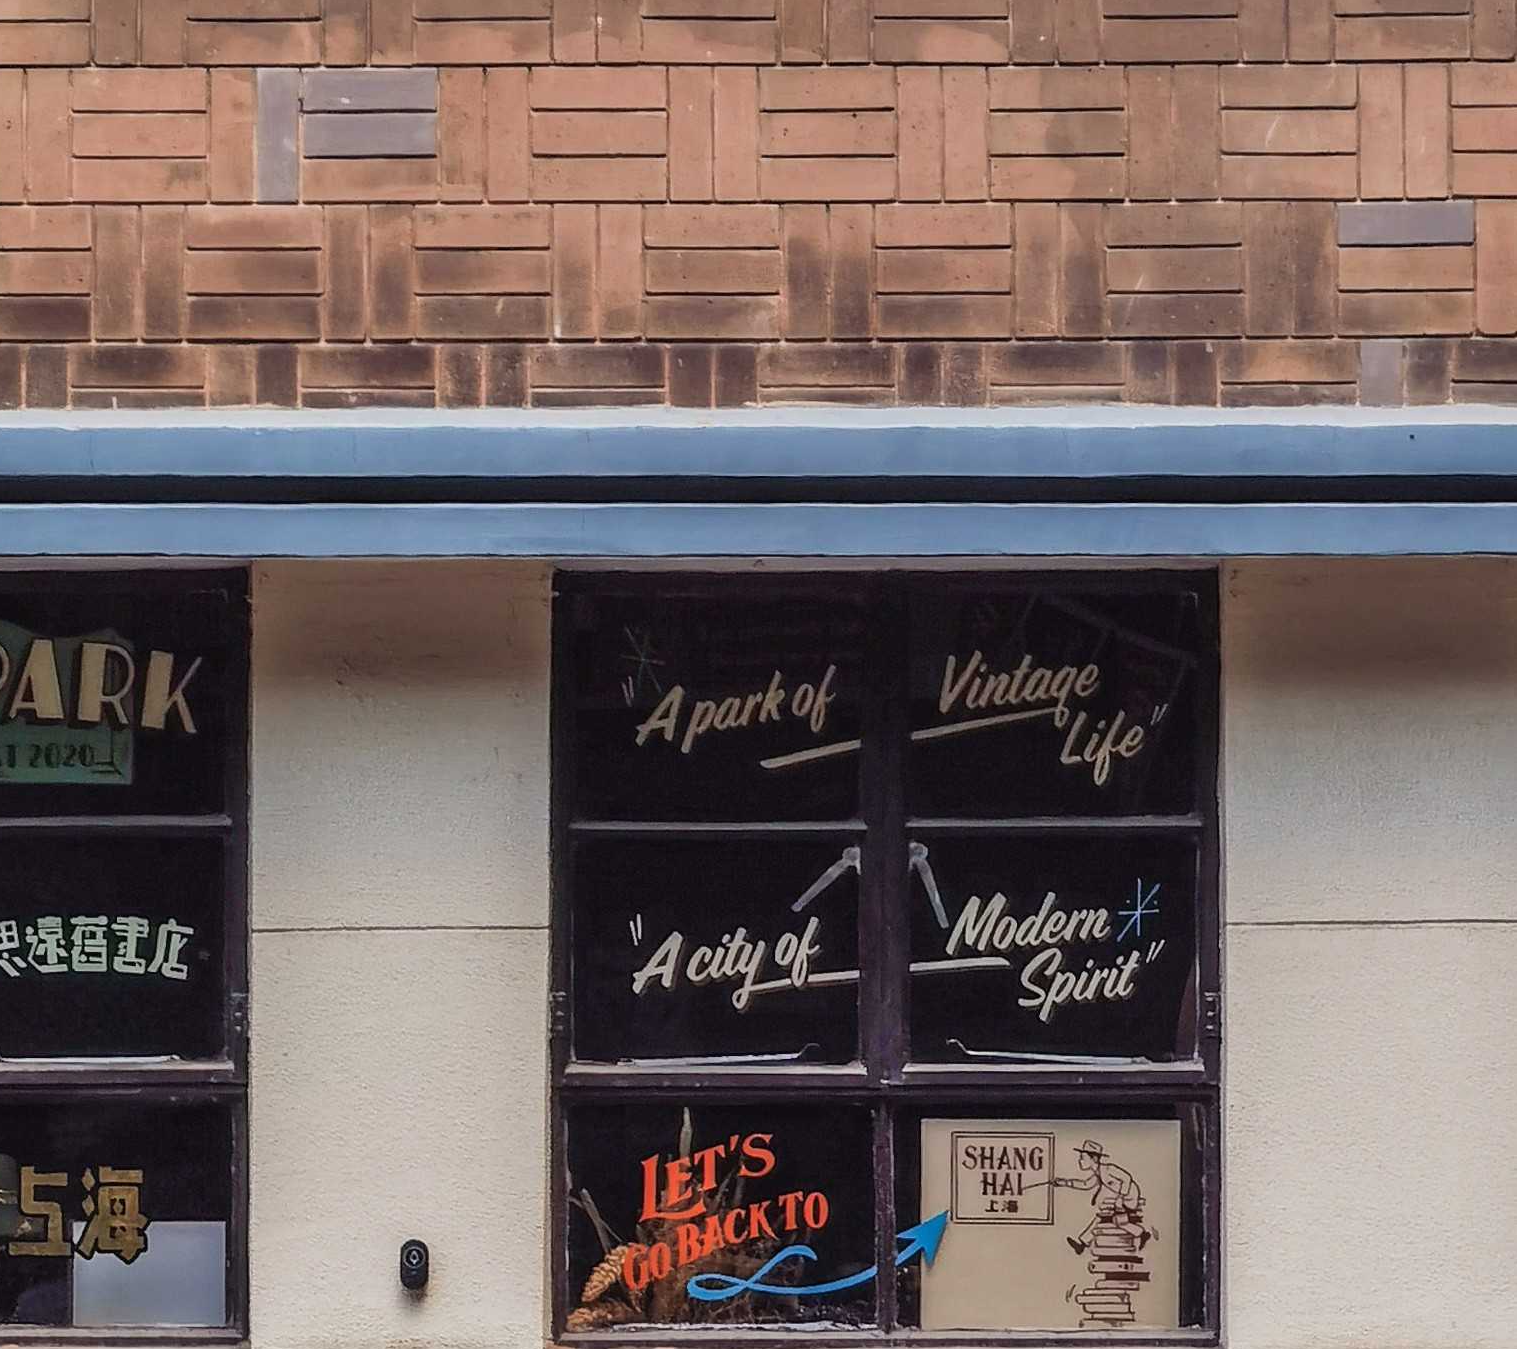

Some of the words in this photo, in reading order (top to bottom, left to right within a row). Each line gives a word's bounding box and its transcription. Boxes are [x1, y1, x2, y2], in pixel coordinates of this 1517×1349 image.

[680, 669, 786, 754] park
[791, 664, 837, 733] of
[938, 650, 1099, 728] Vintage
[29, 742, 96, 769] 2020
[685, 926, 767, 1010] city
[774, 915, 821, 988] of
[945, 891, 1112, 956] Modern
[638, 1132, 776, 1223] LET'S
[961, 1145, 1044, 1171] SHANG
[980, 1172, 1023, 1196] HAI
[622, 1242, 672, 1291] GO
[676, 1200, 780, 1268] BACK
[778, 1190, 830, 1232] TO
